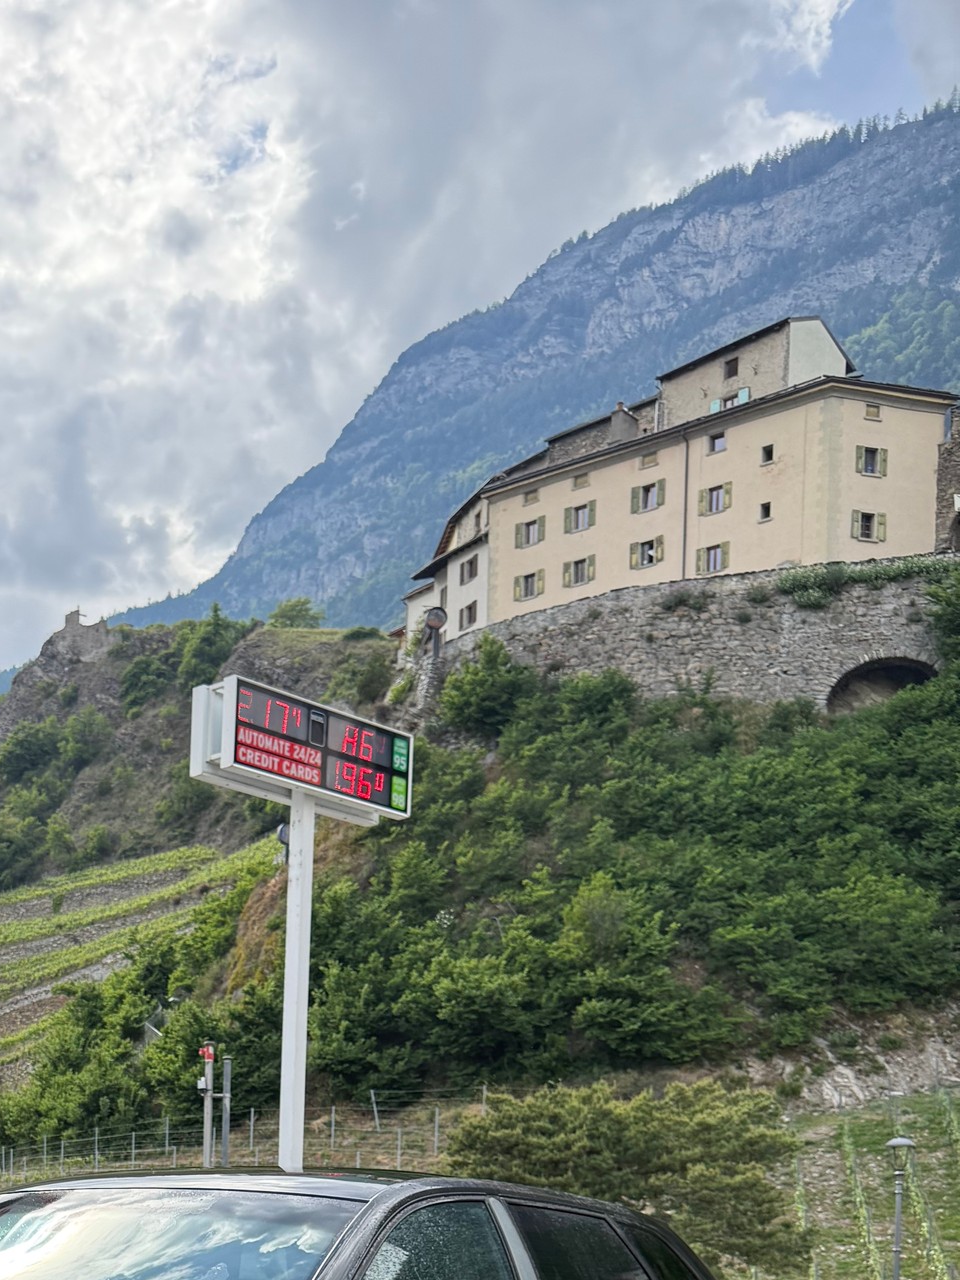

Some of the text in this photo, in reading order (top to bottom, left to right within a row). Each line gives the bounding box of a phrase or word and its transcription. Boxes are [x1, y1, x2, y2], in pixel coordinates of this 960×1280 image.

[237, 728, 322, 766] AUTOMATE 24/24
[239, 747, 319, 783] CREDIT CARDS
[393, 755, 407, 770] 95
